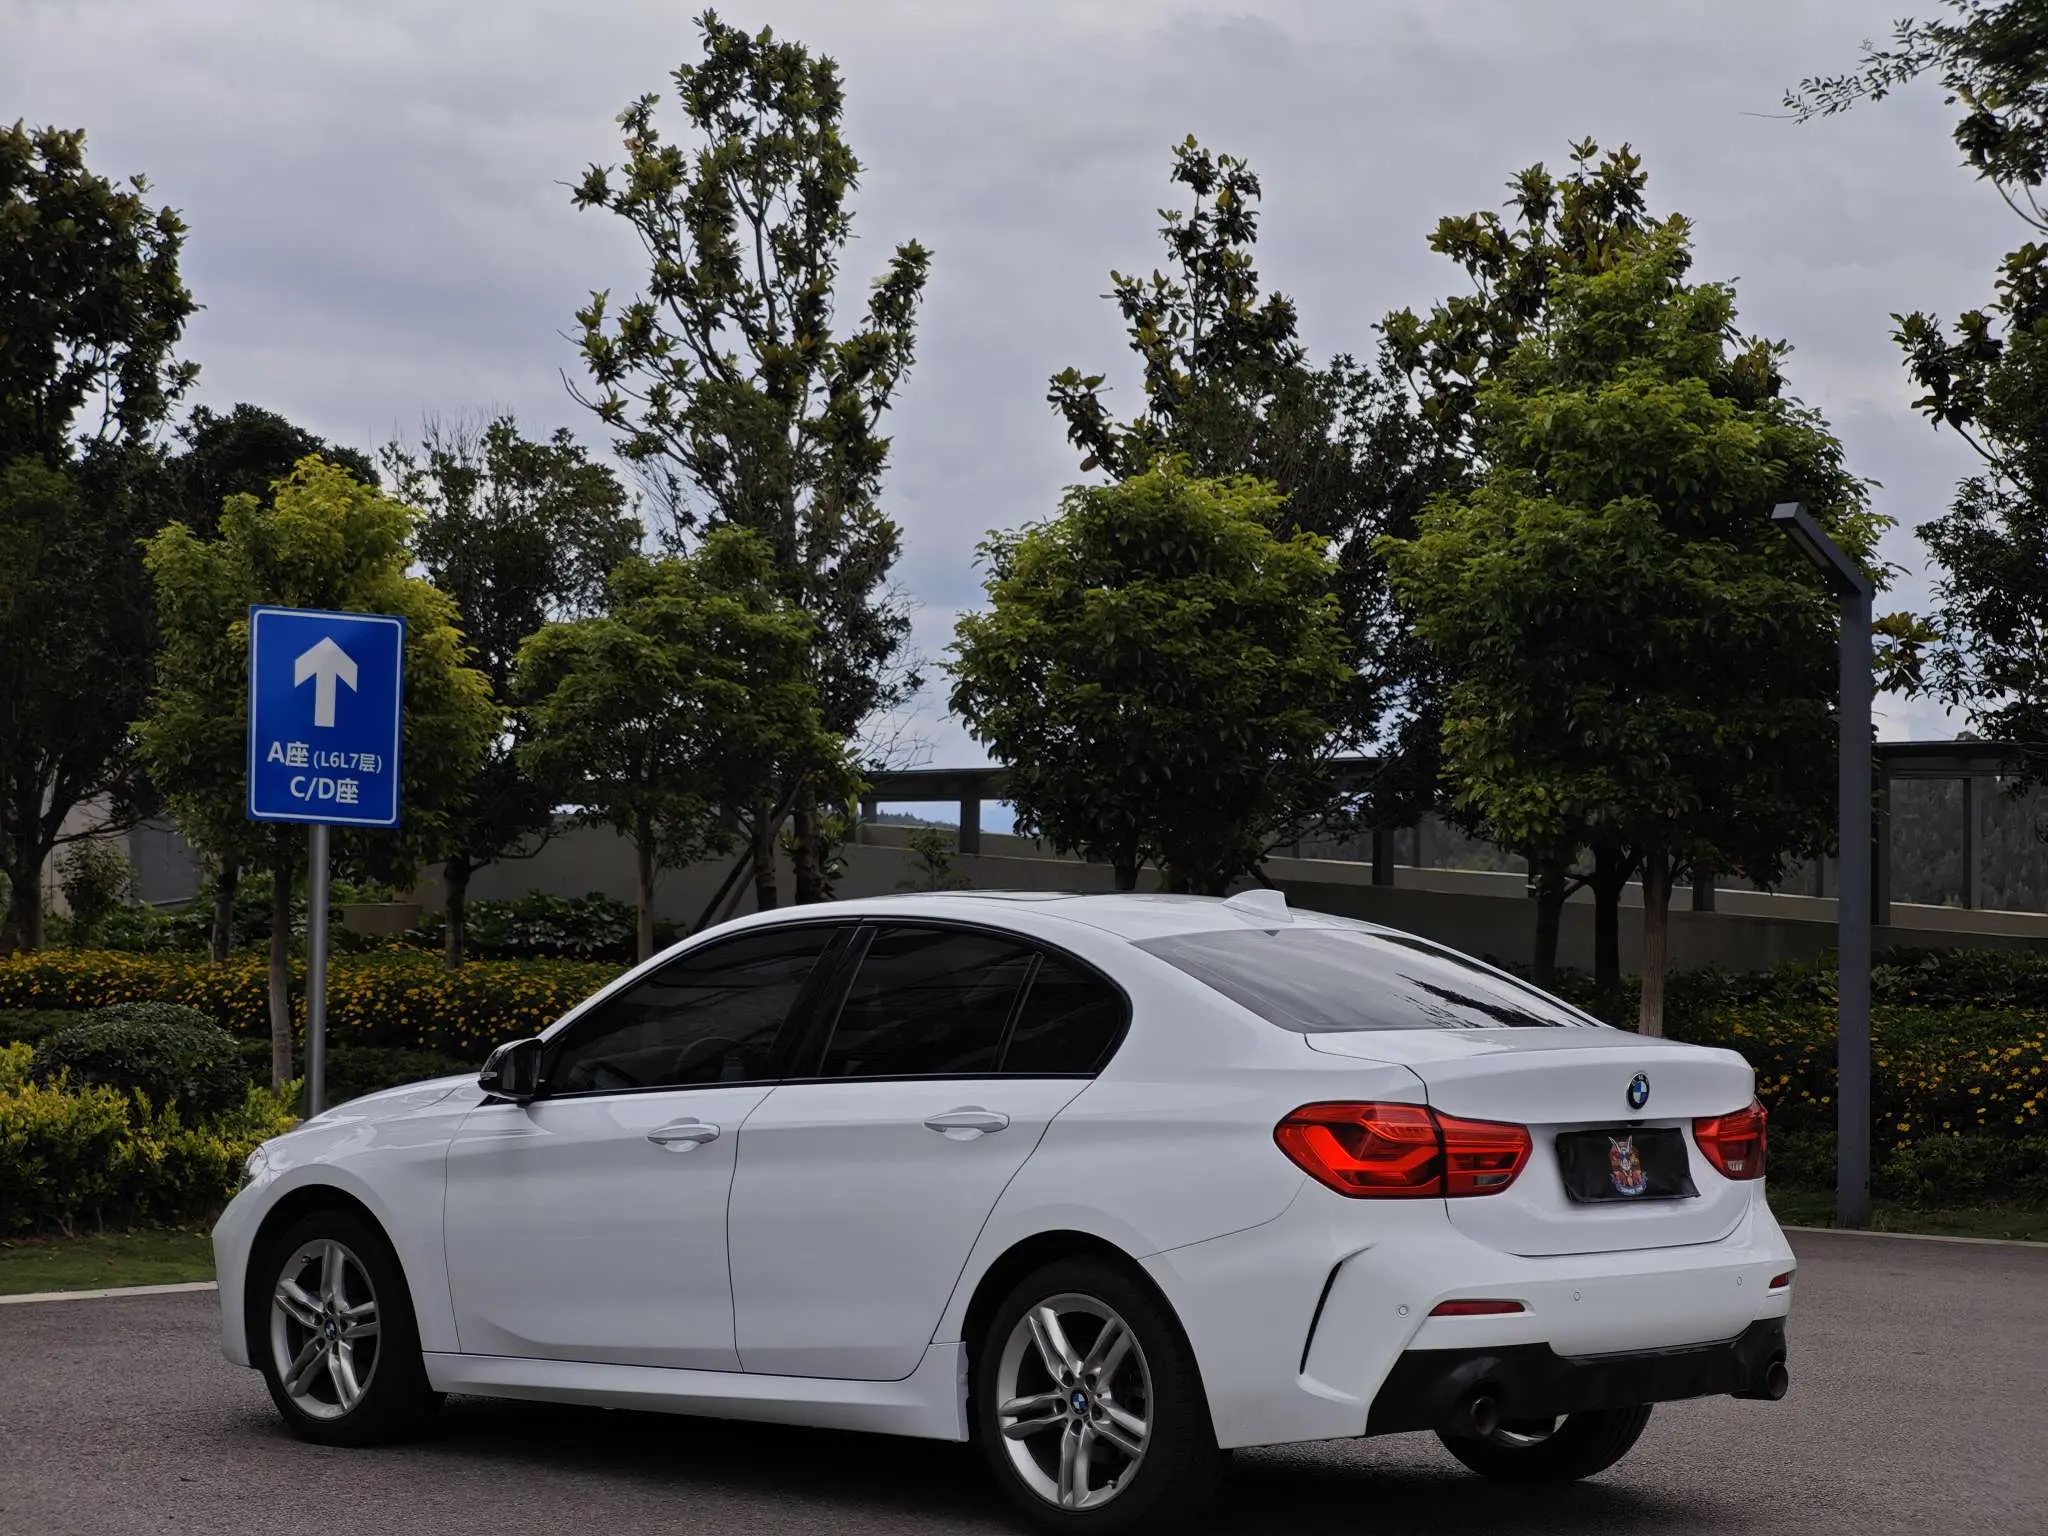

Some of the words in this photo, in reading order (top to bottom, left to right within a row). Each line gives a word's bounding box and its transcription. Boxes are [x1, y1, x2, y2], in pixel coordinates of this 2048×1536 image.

[267, 741, 309, 767] A座
[313, 751, 382, 774] (L6L7层)
[290, 776, 359, 803] C/D座
